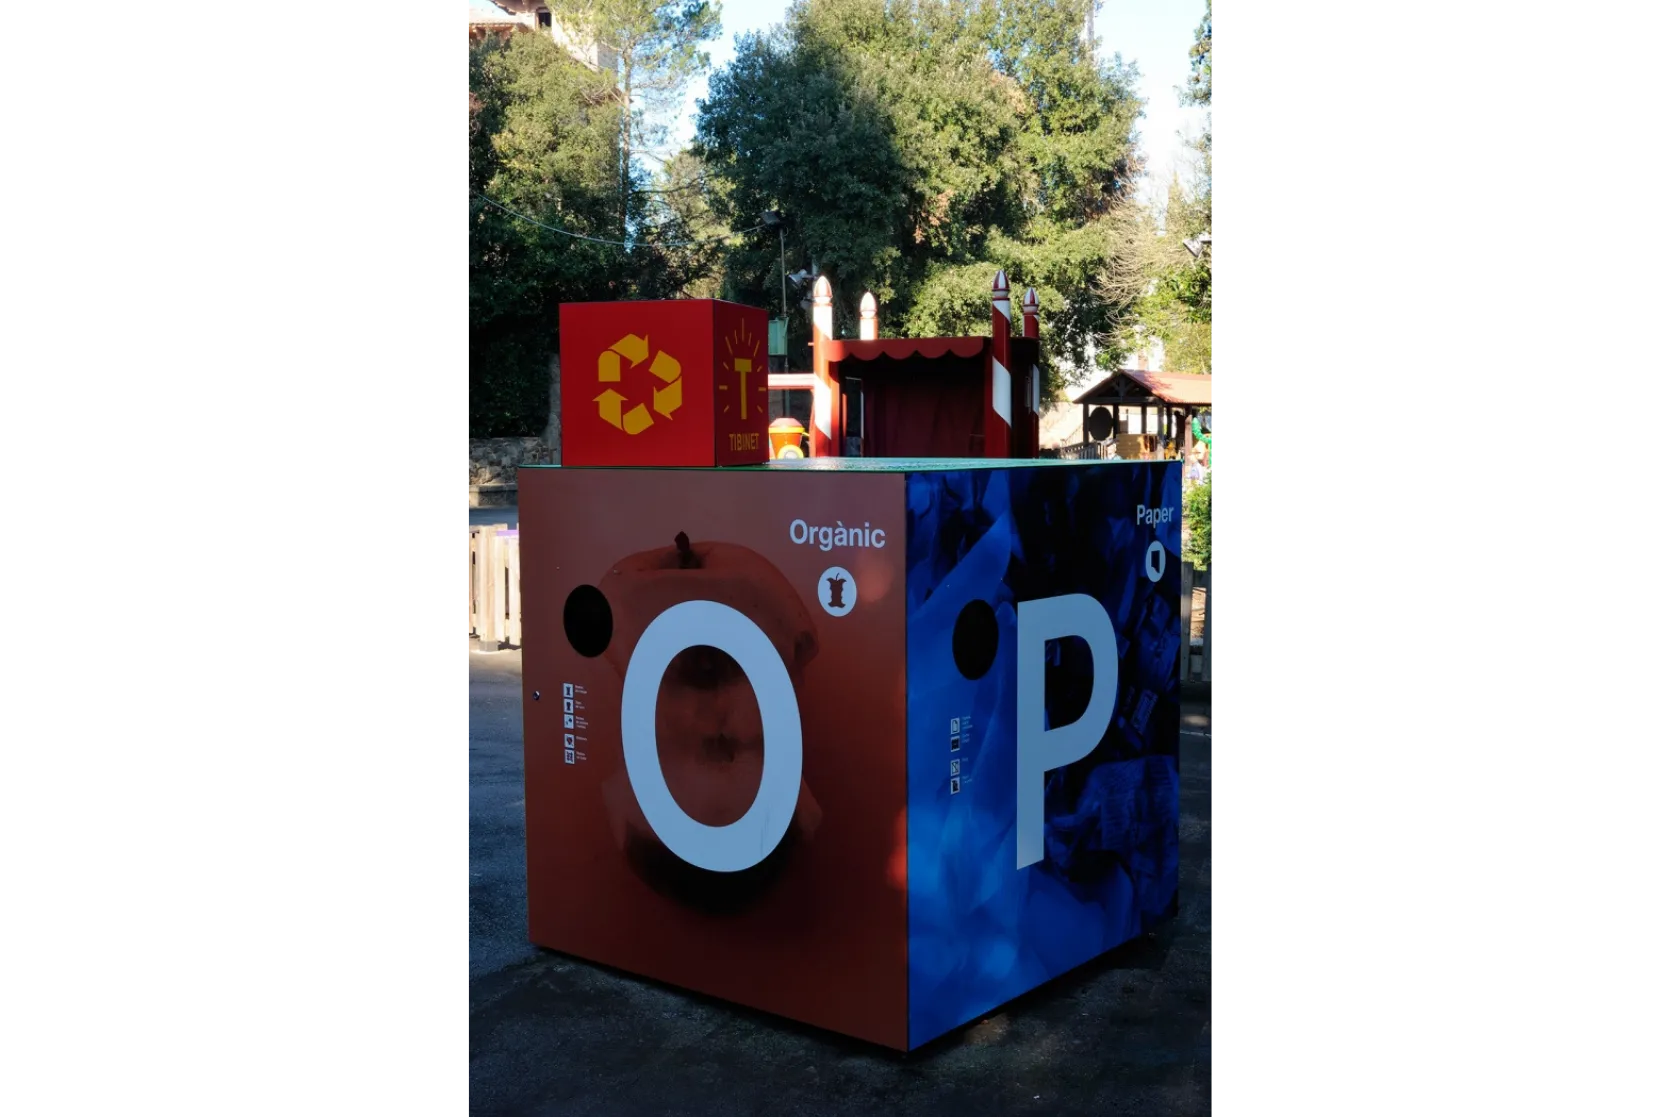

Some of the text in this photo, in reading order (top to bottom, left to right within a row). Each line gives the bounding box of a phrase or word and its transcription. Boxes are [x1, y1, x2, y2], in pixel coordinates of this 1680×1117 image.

[729, 433, 759, 451] TIBINET
[1136, 504, 1174, 528] Paper
[789, 519, 885, 551] Orgànic
[621, 600, 803, 872] O
[1017, 593, 1118, 871] P
